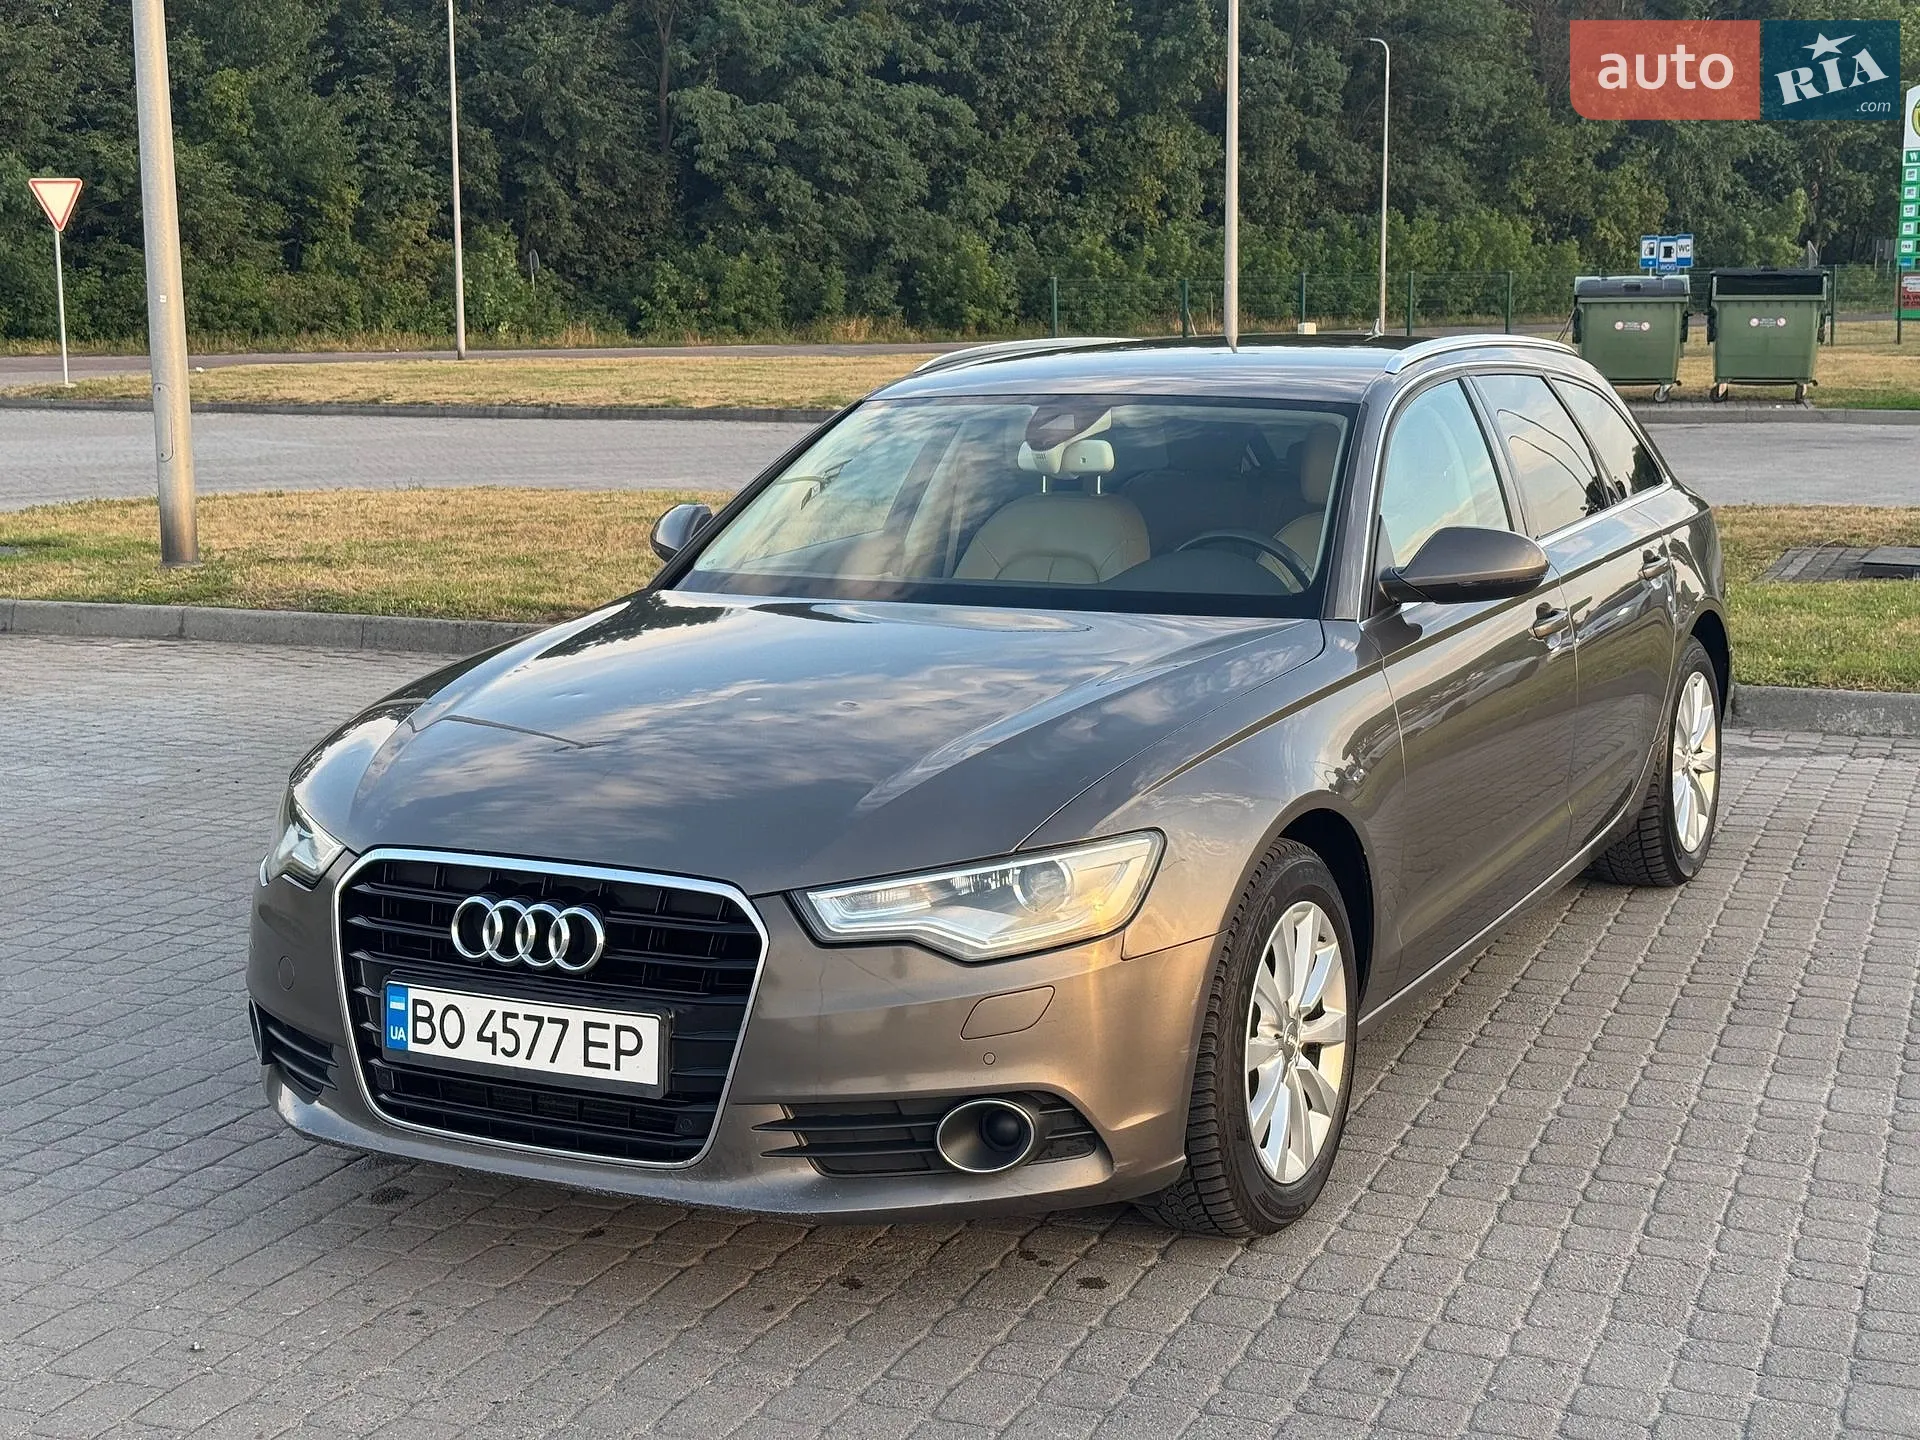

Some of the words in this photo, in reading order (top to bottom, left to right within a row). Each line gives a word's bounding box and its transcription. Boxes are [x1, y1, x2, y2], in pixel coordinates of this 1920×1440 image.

[1678, 244, 1690, 253] WC
[390, 1024, 406, 1042] UA
[412, 998, 466, 1049] BO
[476, 1009, 570, 1063] 4577
[583, 1020, 643, 1071] EP
